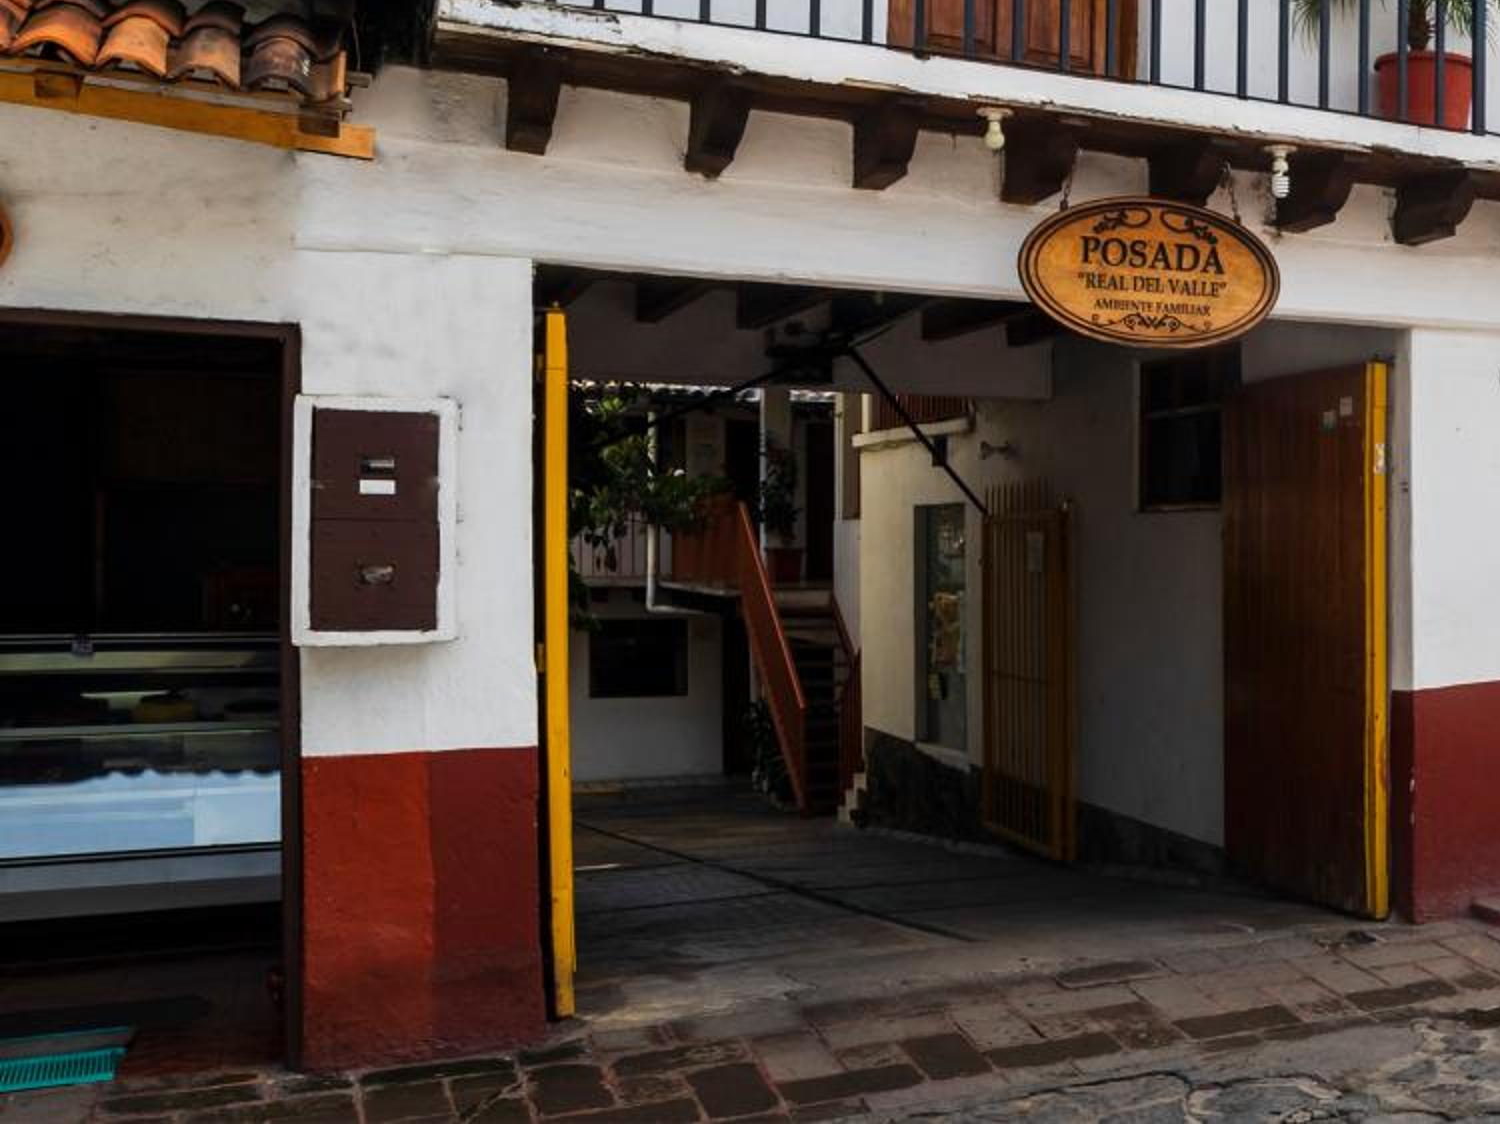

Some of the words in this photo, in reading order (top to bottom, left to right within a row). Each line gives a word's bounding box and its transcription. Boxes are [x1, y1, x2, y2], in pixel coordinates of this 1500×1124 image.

[1080, 235, 1225, 275] POSADA
[1133, 276, 1165, 293] DEL
[1093, 297, 1153, 312] AMBIENTE
[1155, 301, 1212, 317] FAMILIAR
